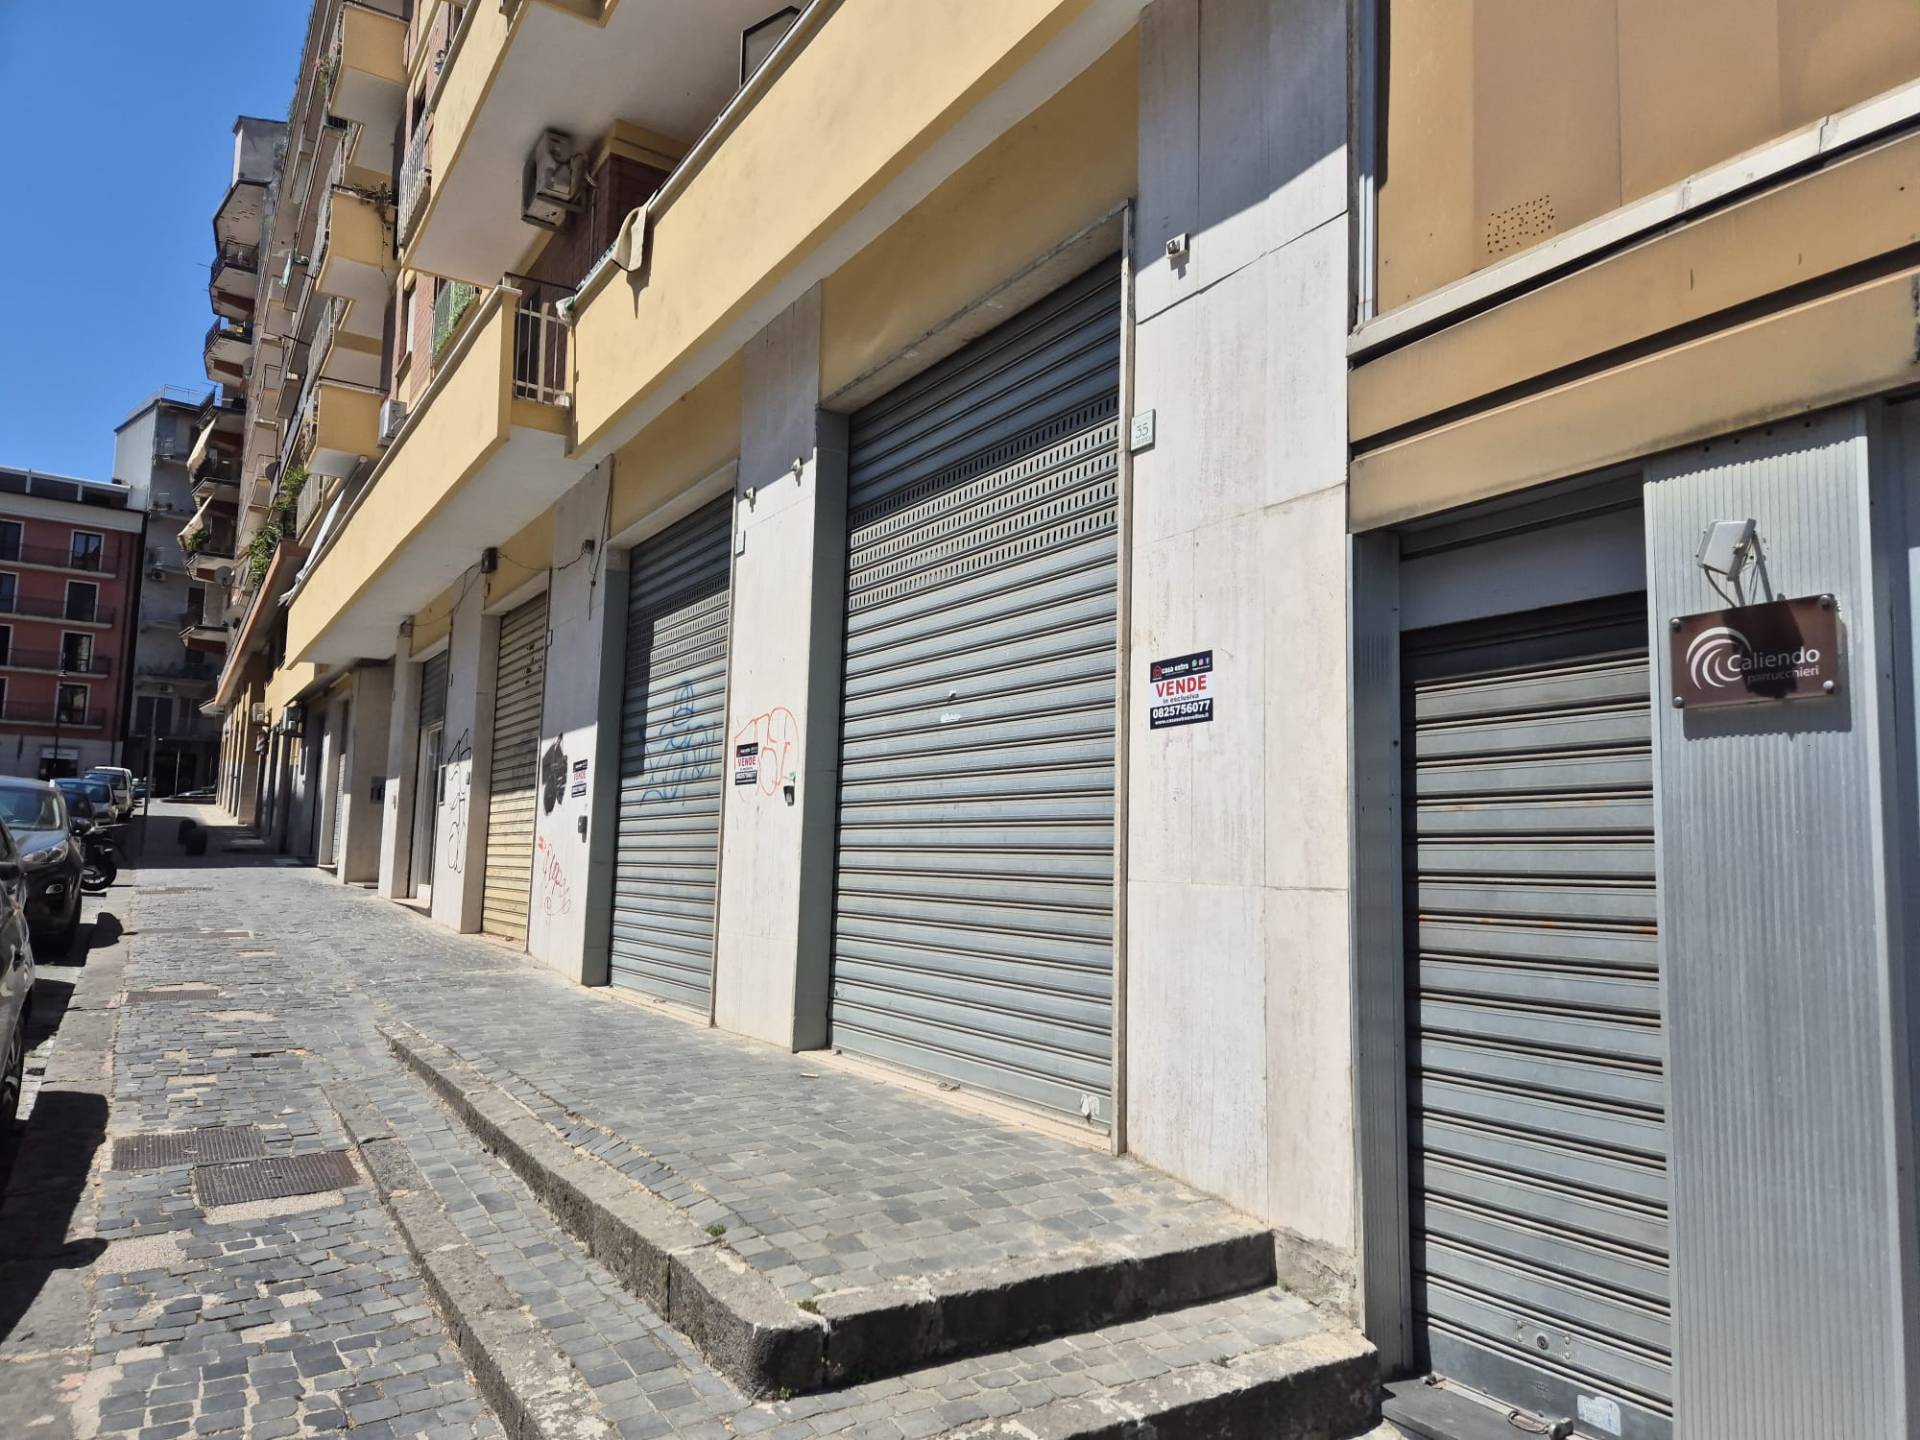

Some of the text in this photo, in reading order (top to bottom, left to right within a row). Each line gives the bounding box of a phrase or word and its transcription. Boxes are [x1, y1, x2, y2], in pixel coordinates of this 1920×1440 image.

[1727, 646, 1820, 672] Caliendo
[1156, 675, 1207, 698] VENDE
[1152, 700, 1210, 719] 0825756077
